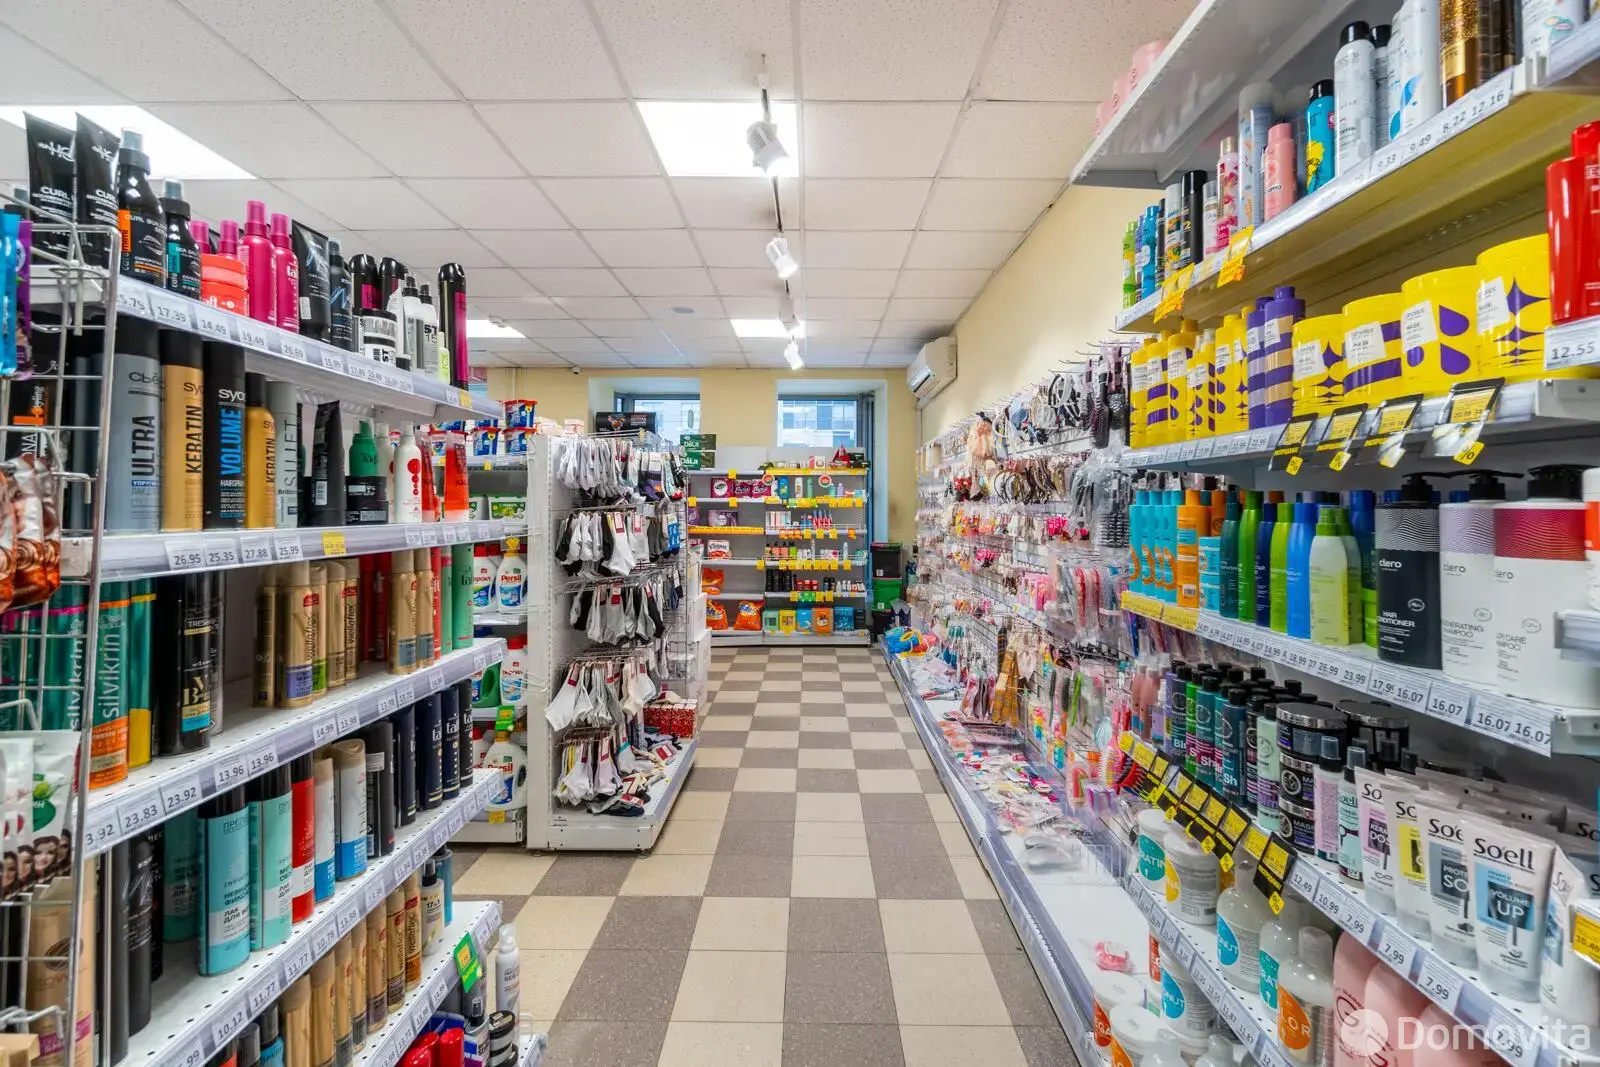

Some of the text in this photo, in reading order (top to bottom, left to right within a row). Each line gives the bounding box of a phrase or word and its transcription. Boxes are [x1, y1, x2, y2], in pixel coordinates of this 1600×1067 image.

[41, 186, 70, 200] CURL
[157, 305, 188, 323] 17.39
[201, 319, 227, 335] 14.49
[1551, 340, 1596, 362] 12.55
[131, 415, 156, 477] ULTRA
[186, 405, 202, 474] KERATIN
[220, 408, 241, 475] VOLUME
[265, 437, 275, 484] KERATIN
[174, 553, 202, 566] 26.95
[209, 551, 235, 562] 25.35
[245, 548, 268, 559] 27.88
[98, 631, 121, 720] silvikrin
[1344, 670, 1366, 684] 23.99
[1397, 687, 1424, 704] 16.07
[1432, 698, 1463, 716] 16.07
[1477, 712, 1511, 733] 16.07
[1514, 722, 1551, 746] 16.07
[250, 753, 275, 769] 13.96
[218, 766, 245, 783] 13.96
[167, 786, 197, 808] 23.92
[124, 804, 158, 829] 23.83
[87, 823, 115, 846] 3.92
[1317, 891, 1341, 915] 10.99
[1489, 887, 1530, 907] VOLUME
[224, 907, 239, 917] ЛАК
[1496, 903, 1525, 919] UP
[1345, 913, 1365, 934] 7.99
[1384, 942, 1405, 965] 7.99
[287, 953, 309, 976] 11.77
[253, 982, 276, 1006] 11.77
[1425, 975, 1450, 1000] 7.99
[217, 1011, 244, 1039] 10.12
